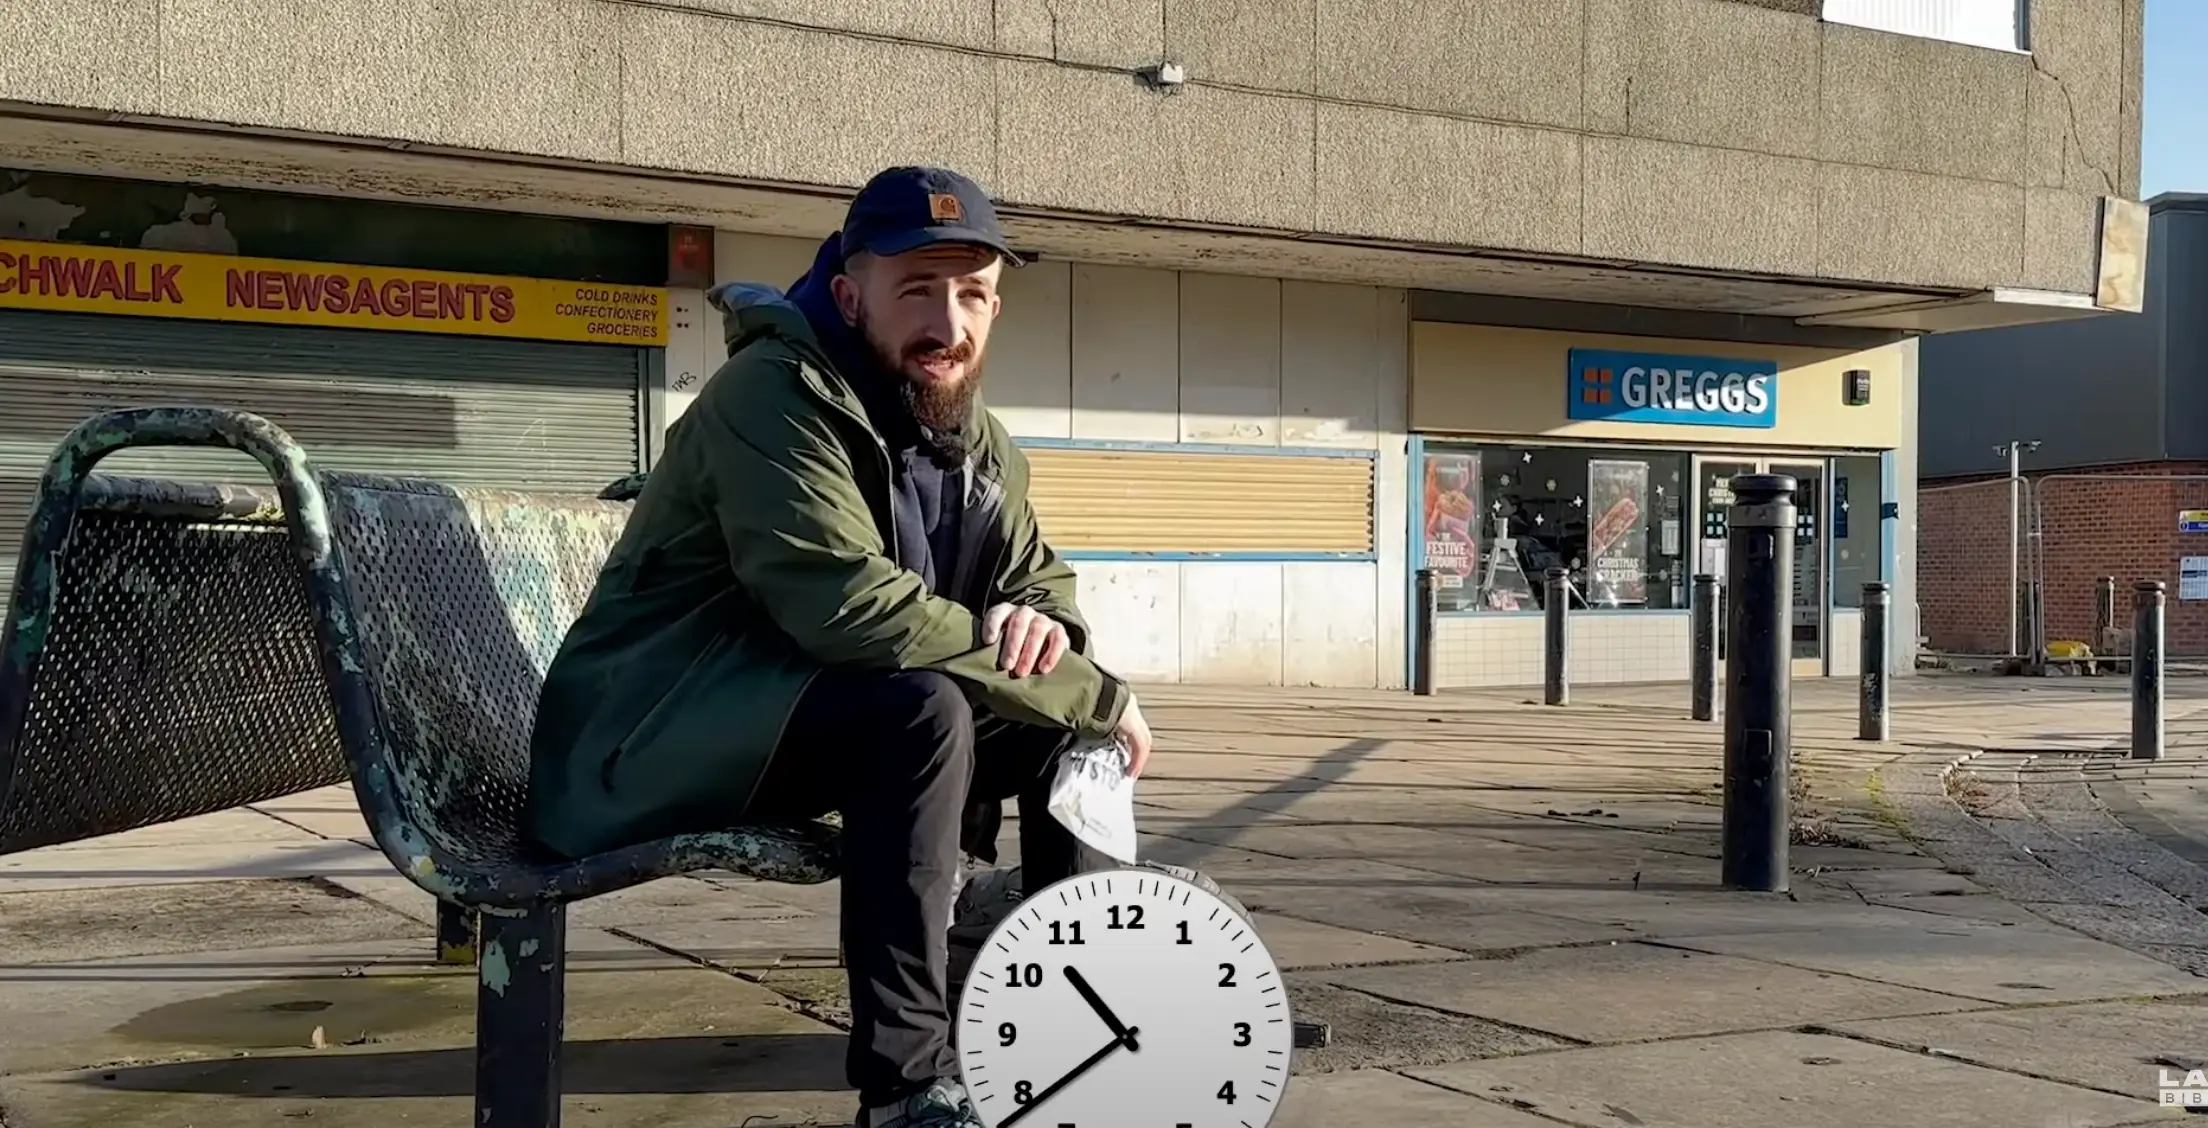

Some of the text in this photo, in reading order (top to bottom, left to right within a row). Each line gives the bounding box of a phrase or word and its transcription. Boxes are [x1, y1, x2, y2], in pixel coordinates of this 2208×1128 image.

[226, 268, 516, 324] NEWSAGENTS
[575, 288, 658, 306] COLD DRINKS
[555, 303, 659, 322] CONFECTIONERY
[587, 322, 658, 338] GROCERIES
[1621, 366, 1769, 414] GREGGS
[1426, 542, 1466, 555] FESTIVE
[1597, 557, 1639, 568] CHRISTMAS
